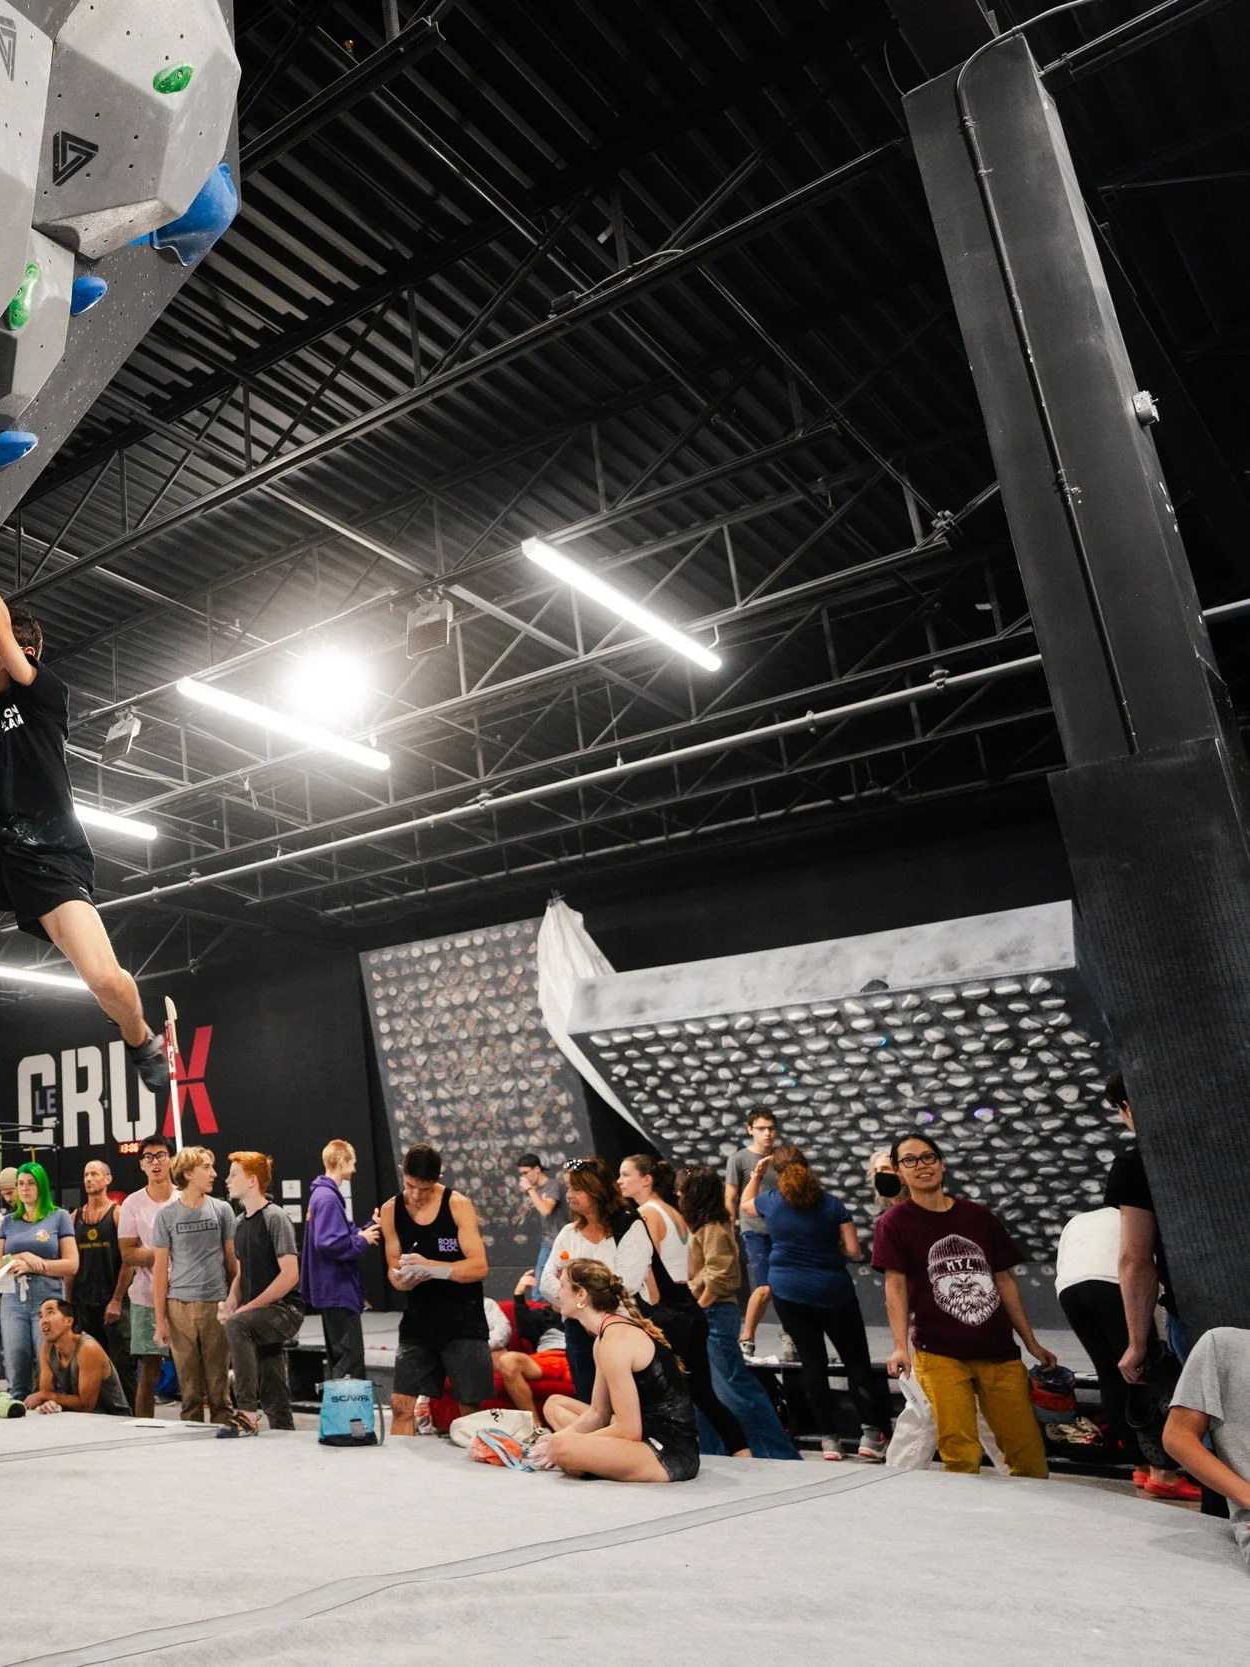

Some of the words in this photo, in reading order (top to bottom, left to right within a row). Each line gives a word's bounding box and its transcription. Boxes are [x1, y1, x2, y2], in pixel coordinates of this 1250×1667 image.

[17, 1025, 220, 1150] CRUX
[35, 1088, 56, 1115] LE
[946, 1258, 973, 1271] MTL
